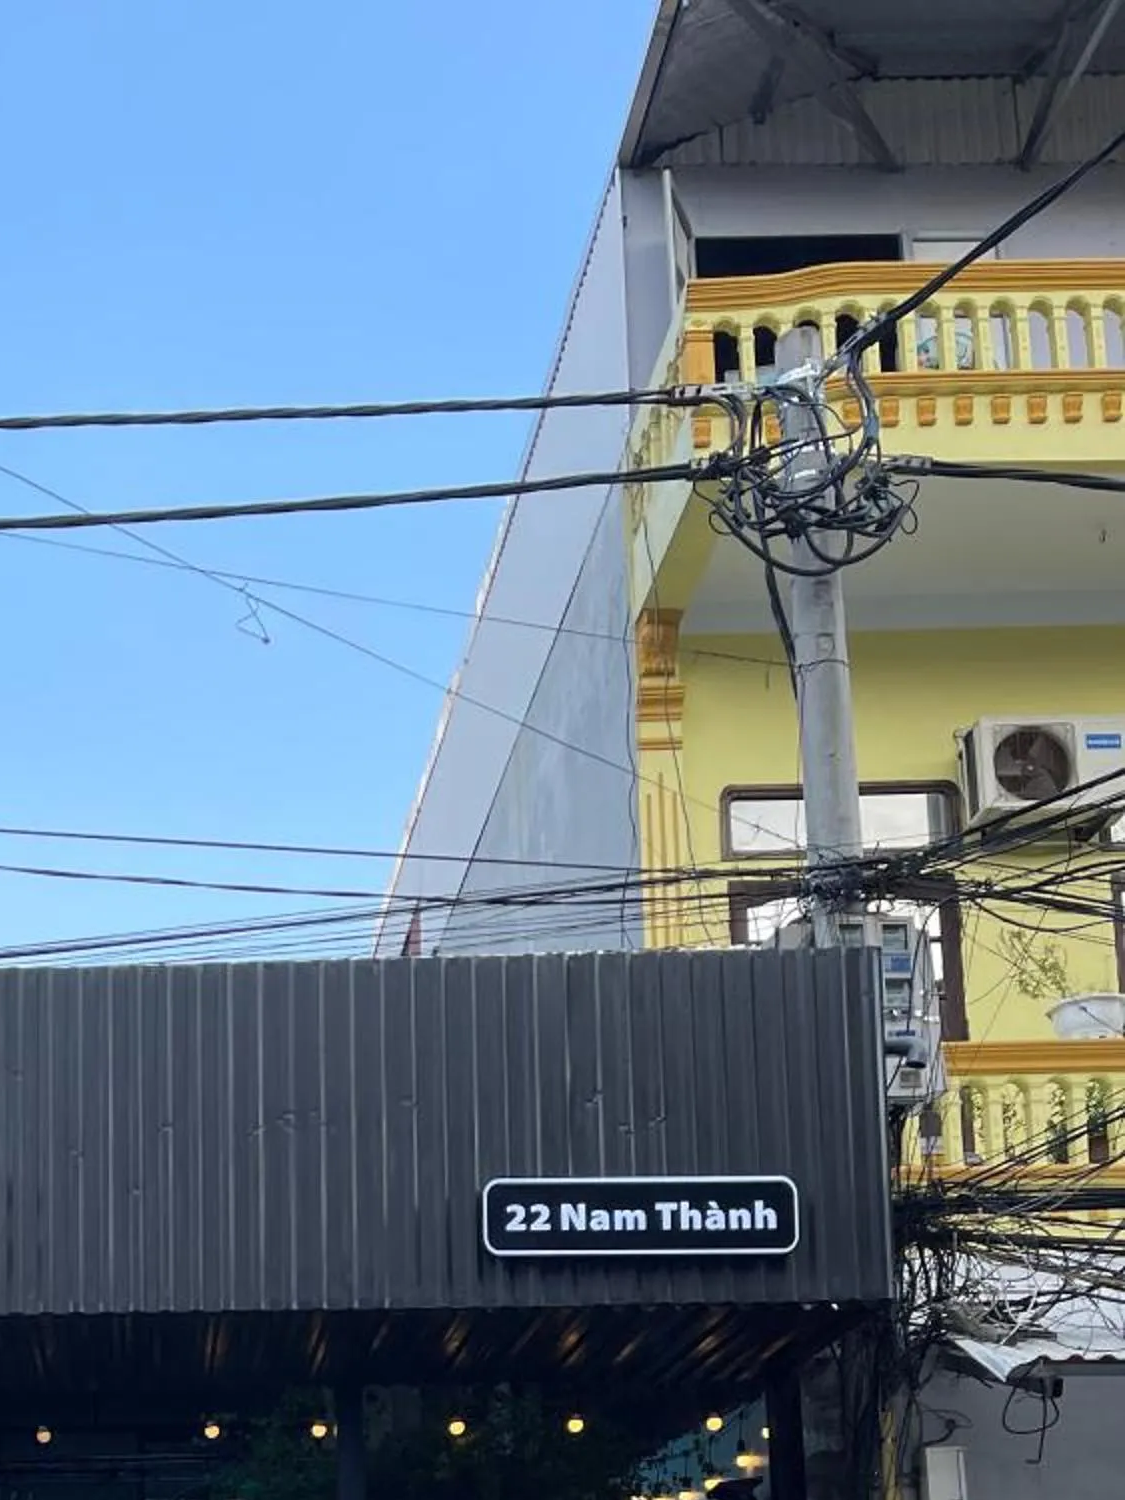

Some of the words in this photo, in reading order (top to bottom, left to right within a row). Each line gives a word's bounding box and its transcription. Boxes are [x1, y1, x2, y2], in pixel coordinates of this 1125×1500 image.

[505, 1204, 552, 1232] 22
[560, 1203, 647, 1232] Nam
[654, 1200, 778, 1232] Thành
